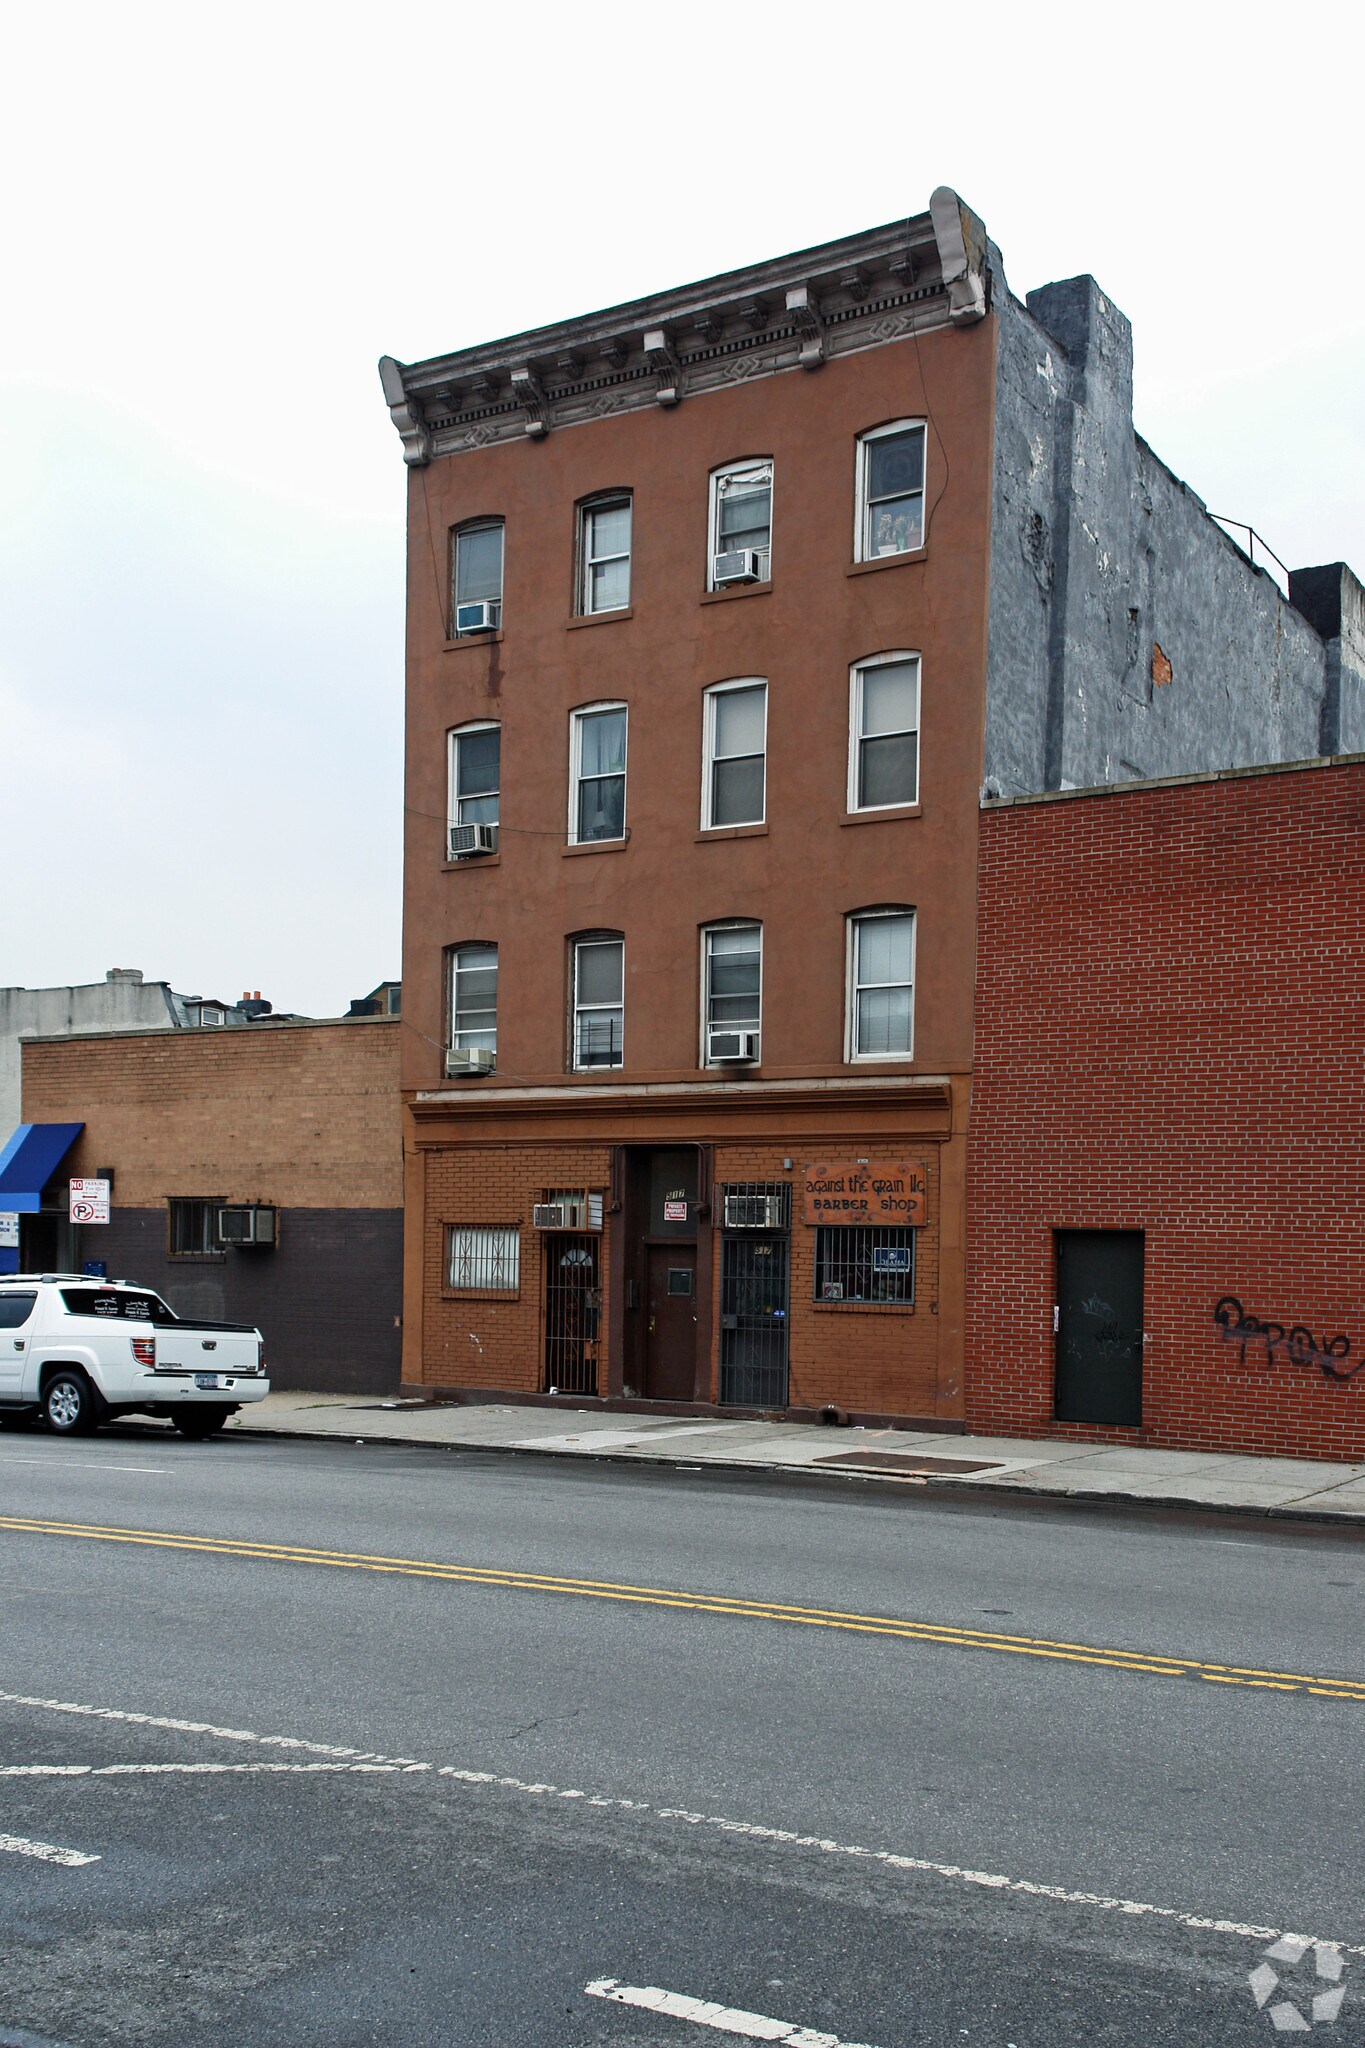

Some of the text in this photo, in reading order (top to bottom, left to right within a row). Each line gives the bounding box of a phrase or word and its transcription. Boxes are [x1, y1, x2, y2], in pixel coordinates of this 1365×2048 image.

[71, 1181, 82, 1189] NO
[806, 1177, 845, 1194] against
[848, 1174, 868, 1193] the
[910, 1174, 925, 1195] llc
[665, 1188, 685, 1201] 517
[881, 1195, 917, 1213] shop
[754, 1246, 772, 1255] 517
